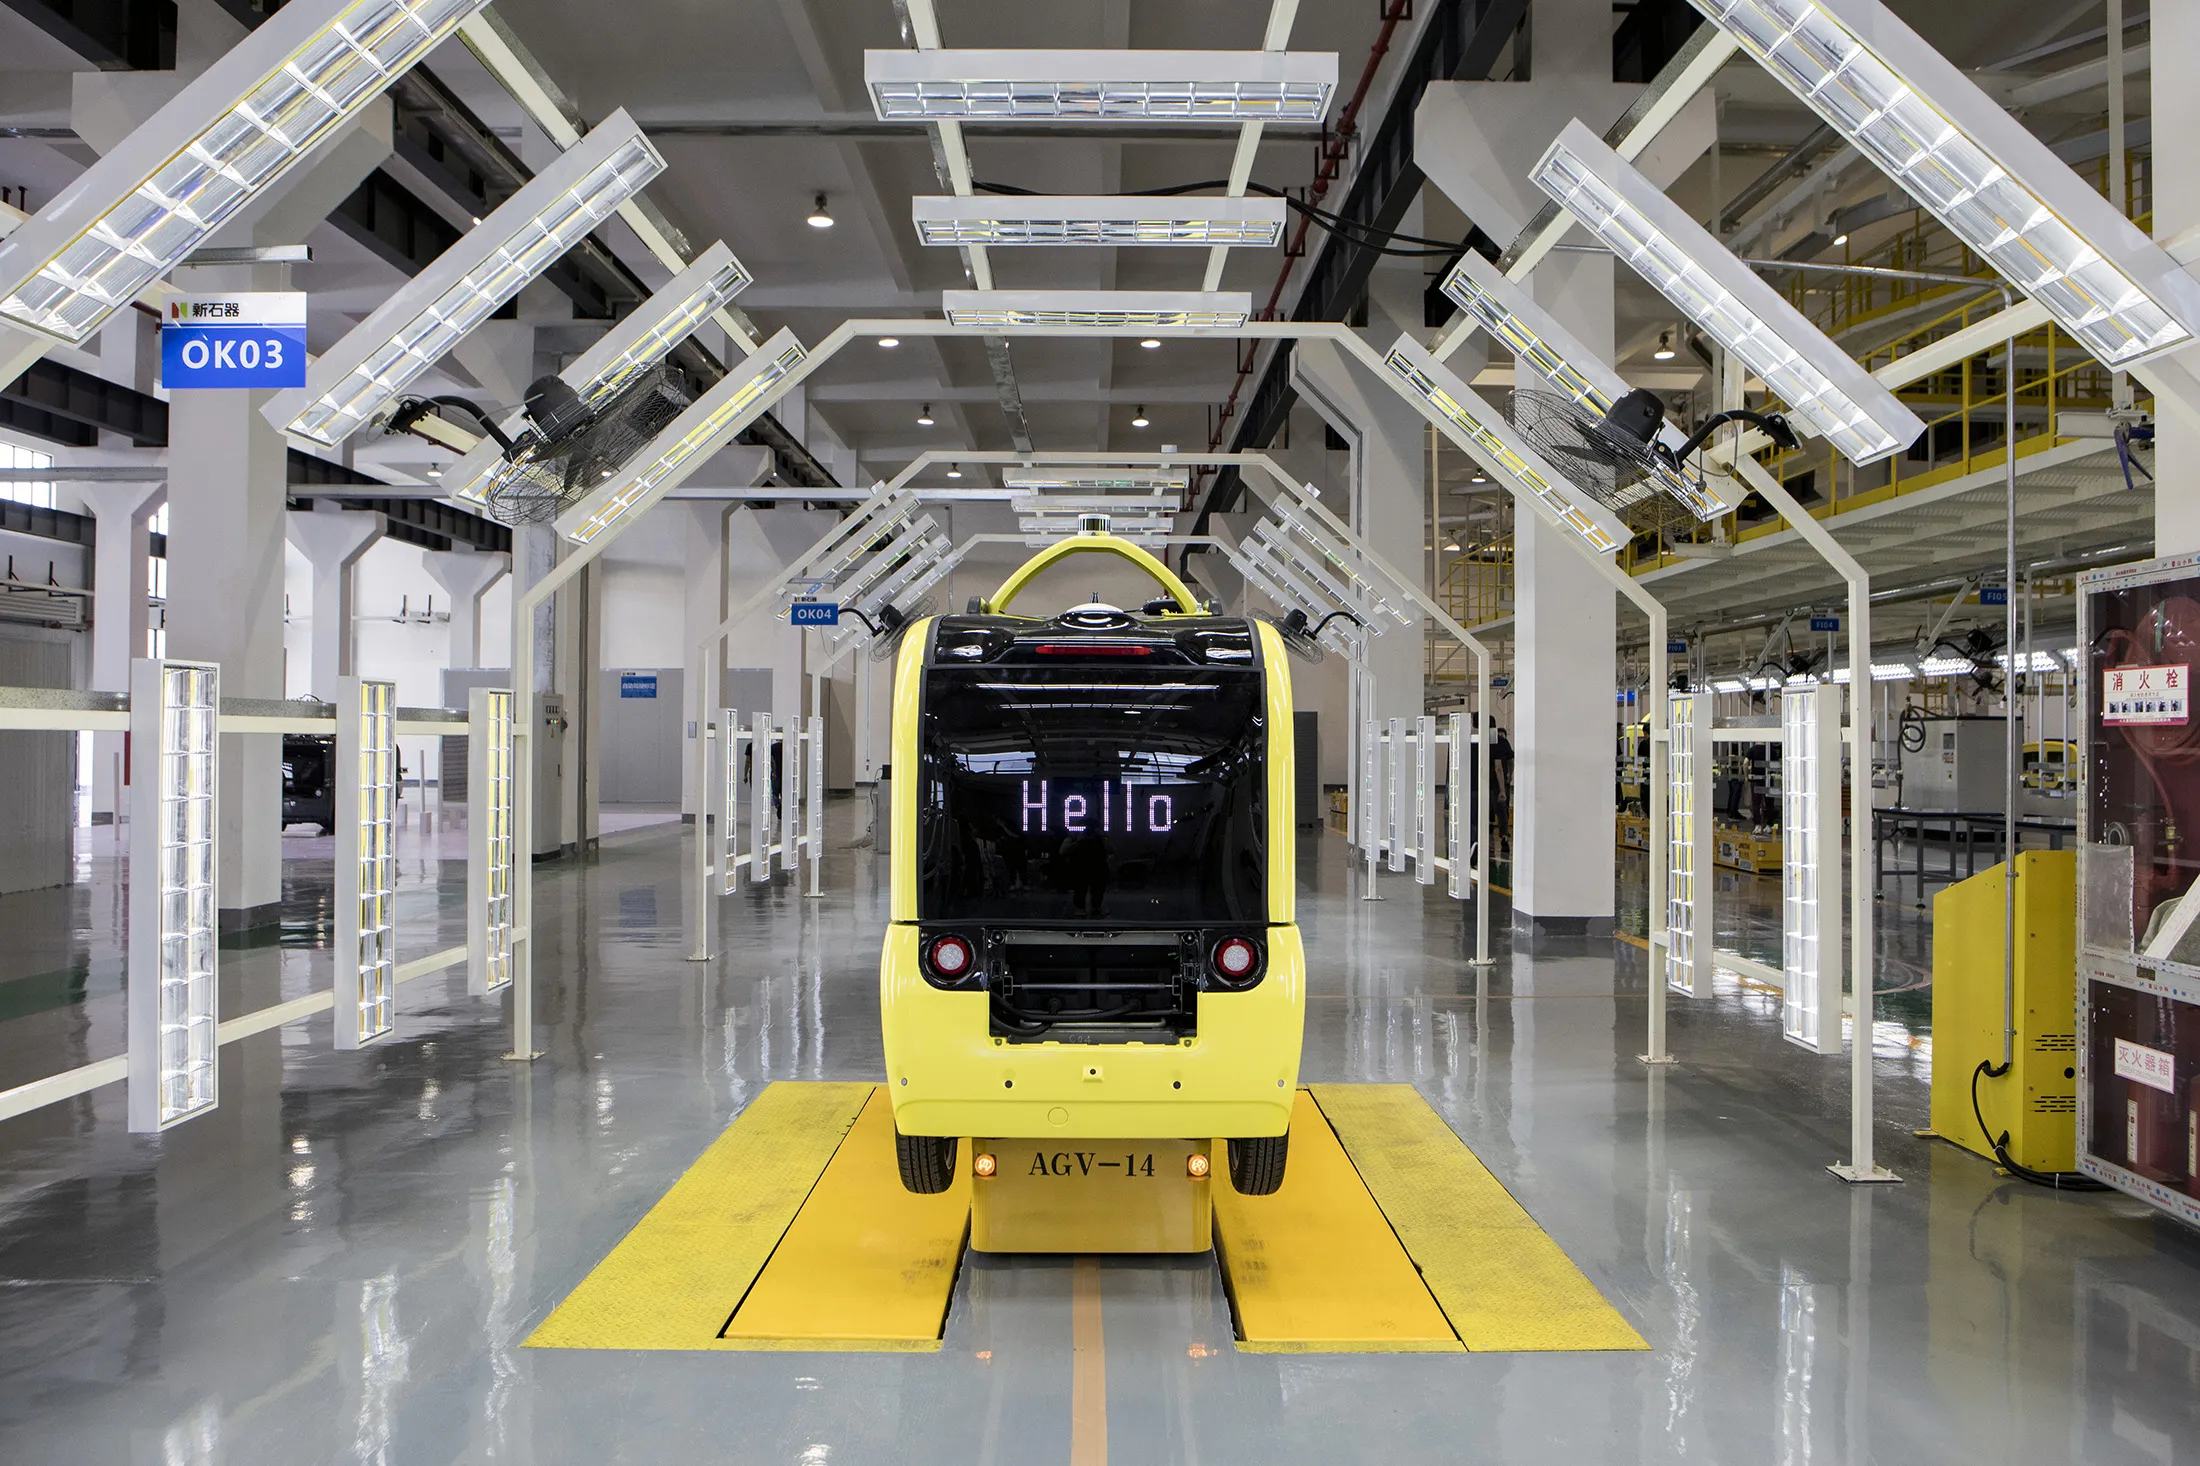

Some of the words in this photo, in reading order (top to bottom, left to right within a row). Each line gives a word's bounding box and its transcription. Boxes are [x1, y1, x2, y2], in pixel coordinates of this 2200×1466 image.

[192, 302, 240, 318] 新石器
[181, 339, 284, 369] OK03
[797, 608, 832, 619] OK04
[2112, 668, 2178, 691] 消火栓
[1022, 780, 1172, 832] Hello
[2118, 1045, 2170, 1077] 灭火器箱
